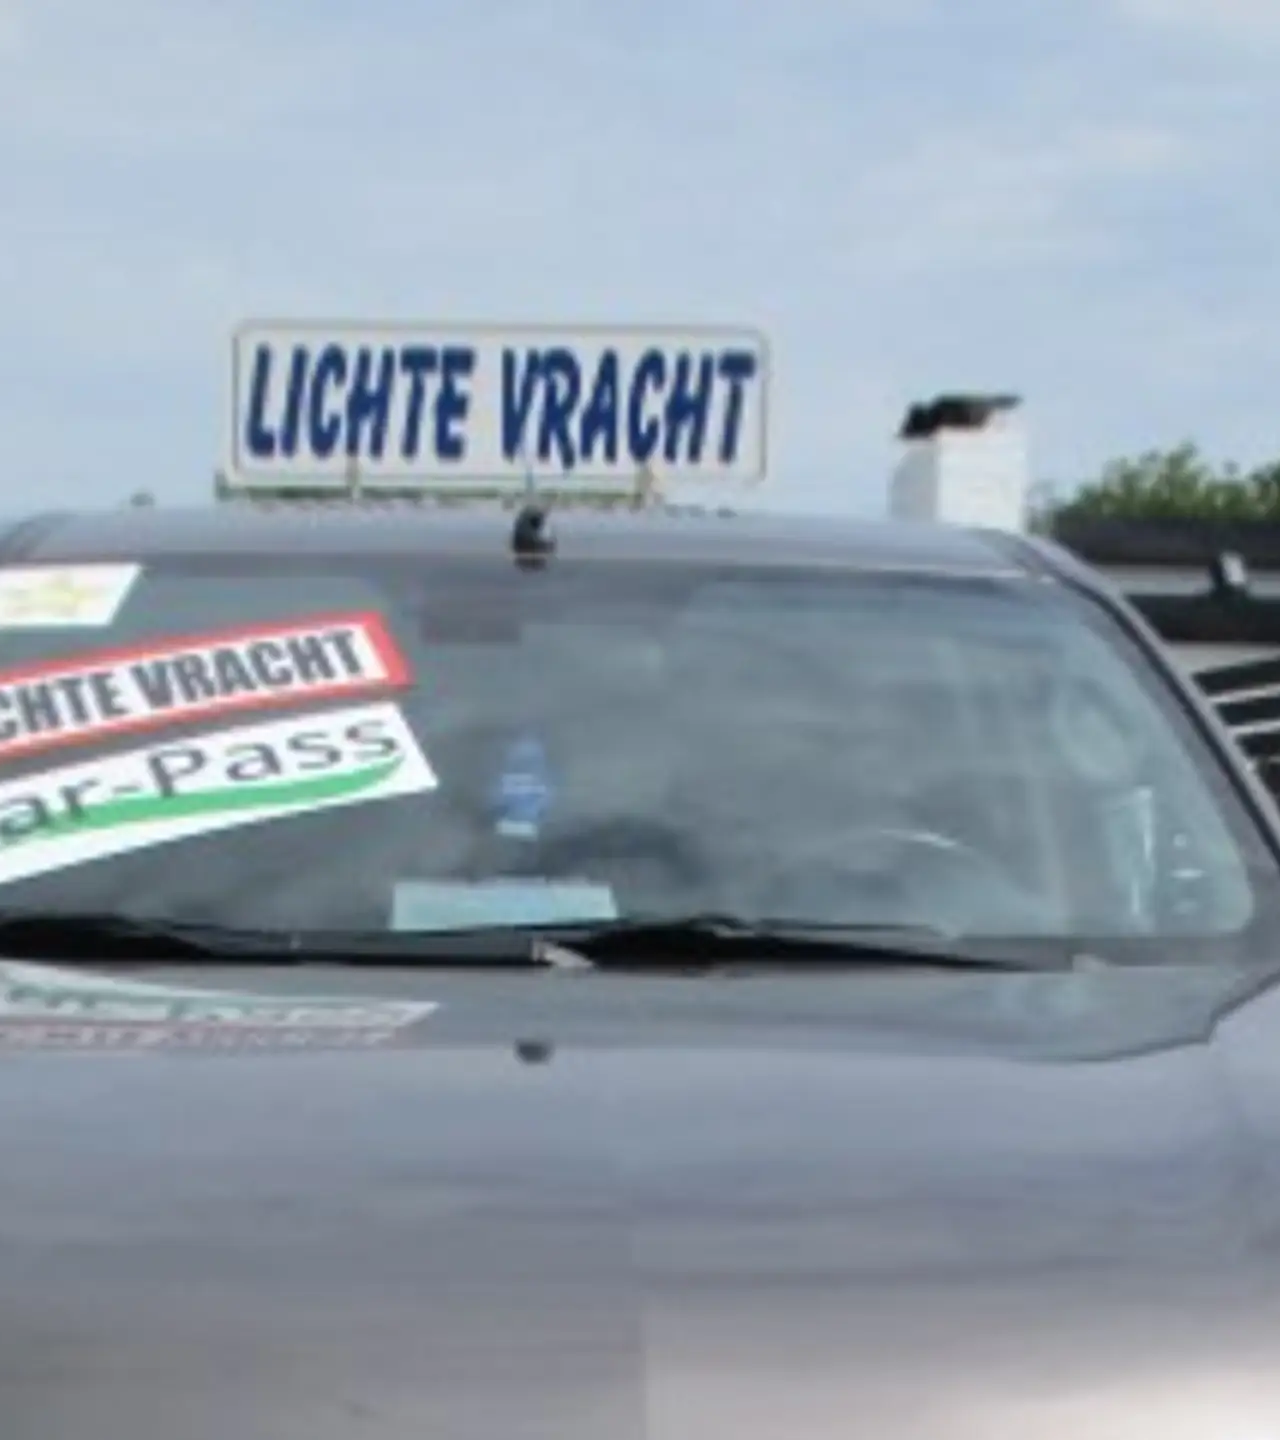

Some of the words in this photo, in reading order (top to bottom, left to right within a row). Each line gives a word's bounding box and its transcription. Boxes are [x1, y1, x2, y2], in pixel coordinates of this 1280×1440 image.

[244, 343, 476, 460] LICHTE
[502, 348, 757, 469] VRACHT
[133, 629, 366, 711] VRACHT
